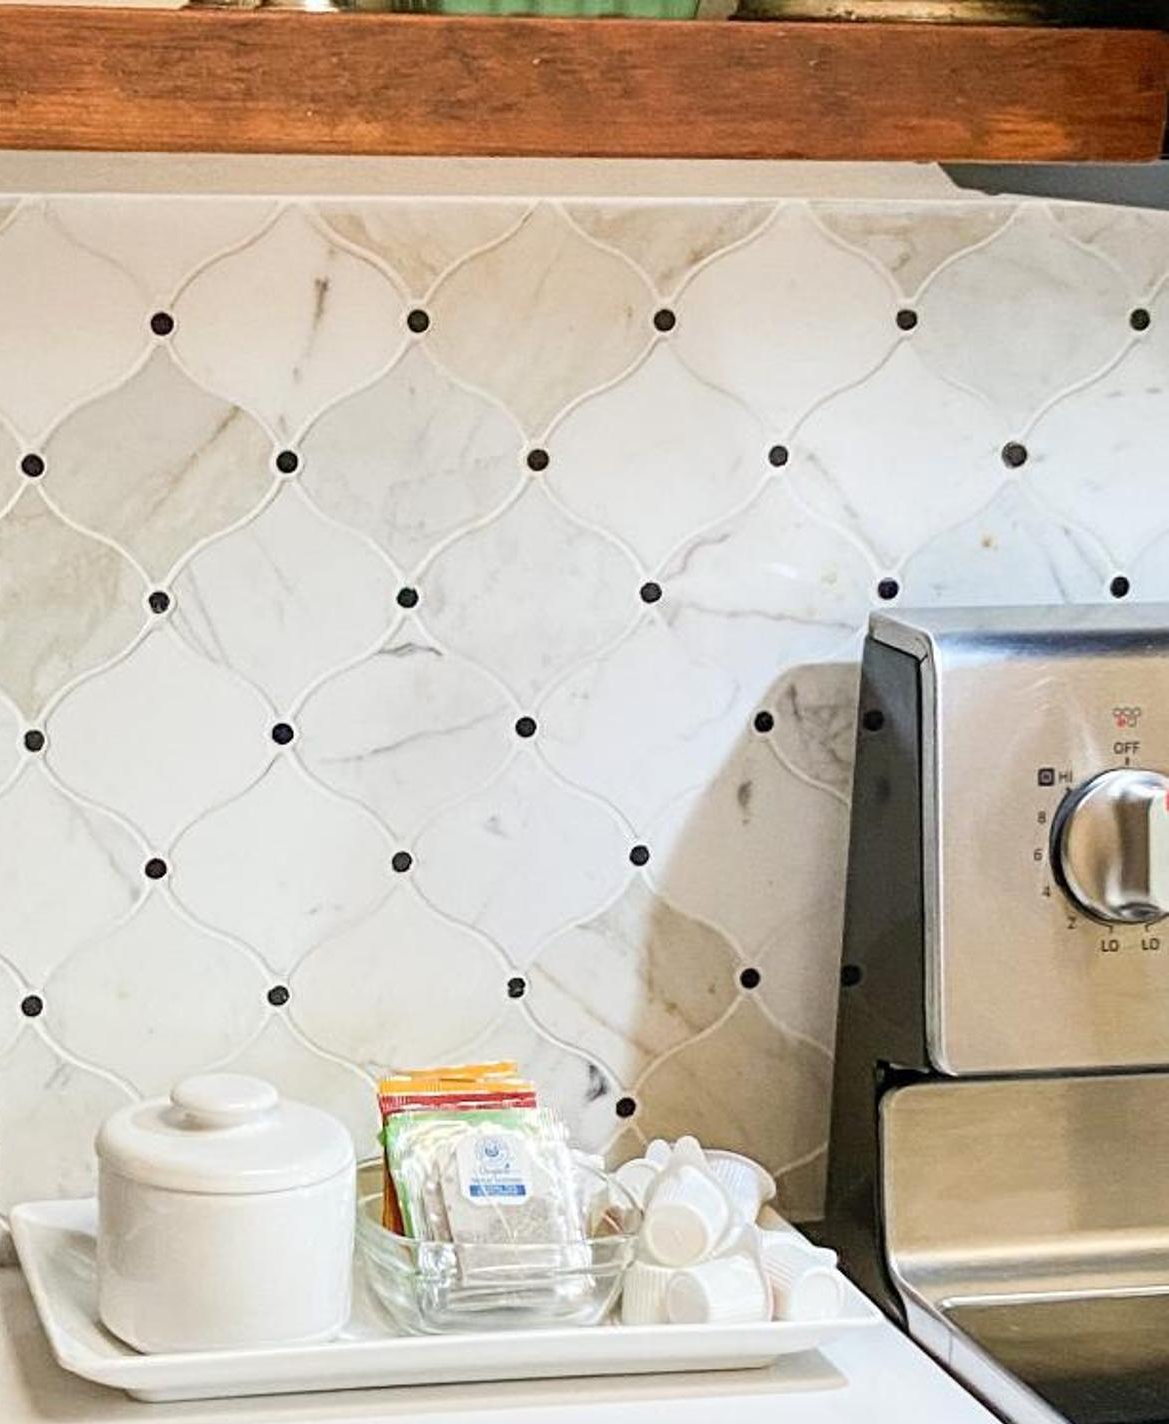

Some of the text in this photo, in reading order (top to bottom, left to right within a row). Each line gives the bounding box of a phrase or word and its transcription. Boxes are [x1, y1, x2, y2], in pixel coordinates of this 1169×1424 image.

[1113, 741, 1141, 755] OFF
[1058, 770, 1073, 784] HI
[1033, 848, 1043, 862] 6
[1042, 885, 1051, 898] 4
[1101, 939, 1120, 953] LO
[1141, 937, 1160, 951] LO
